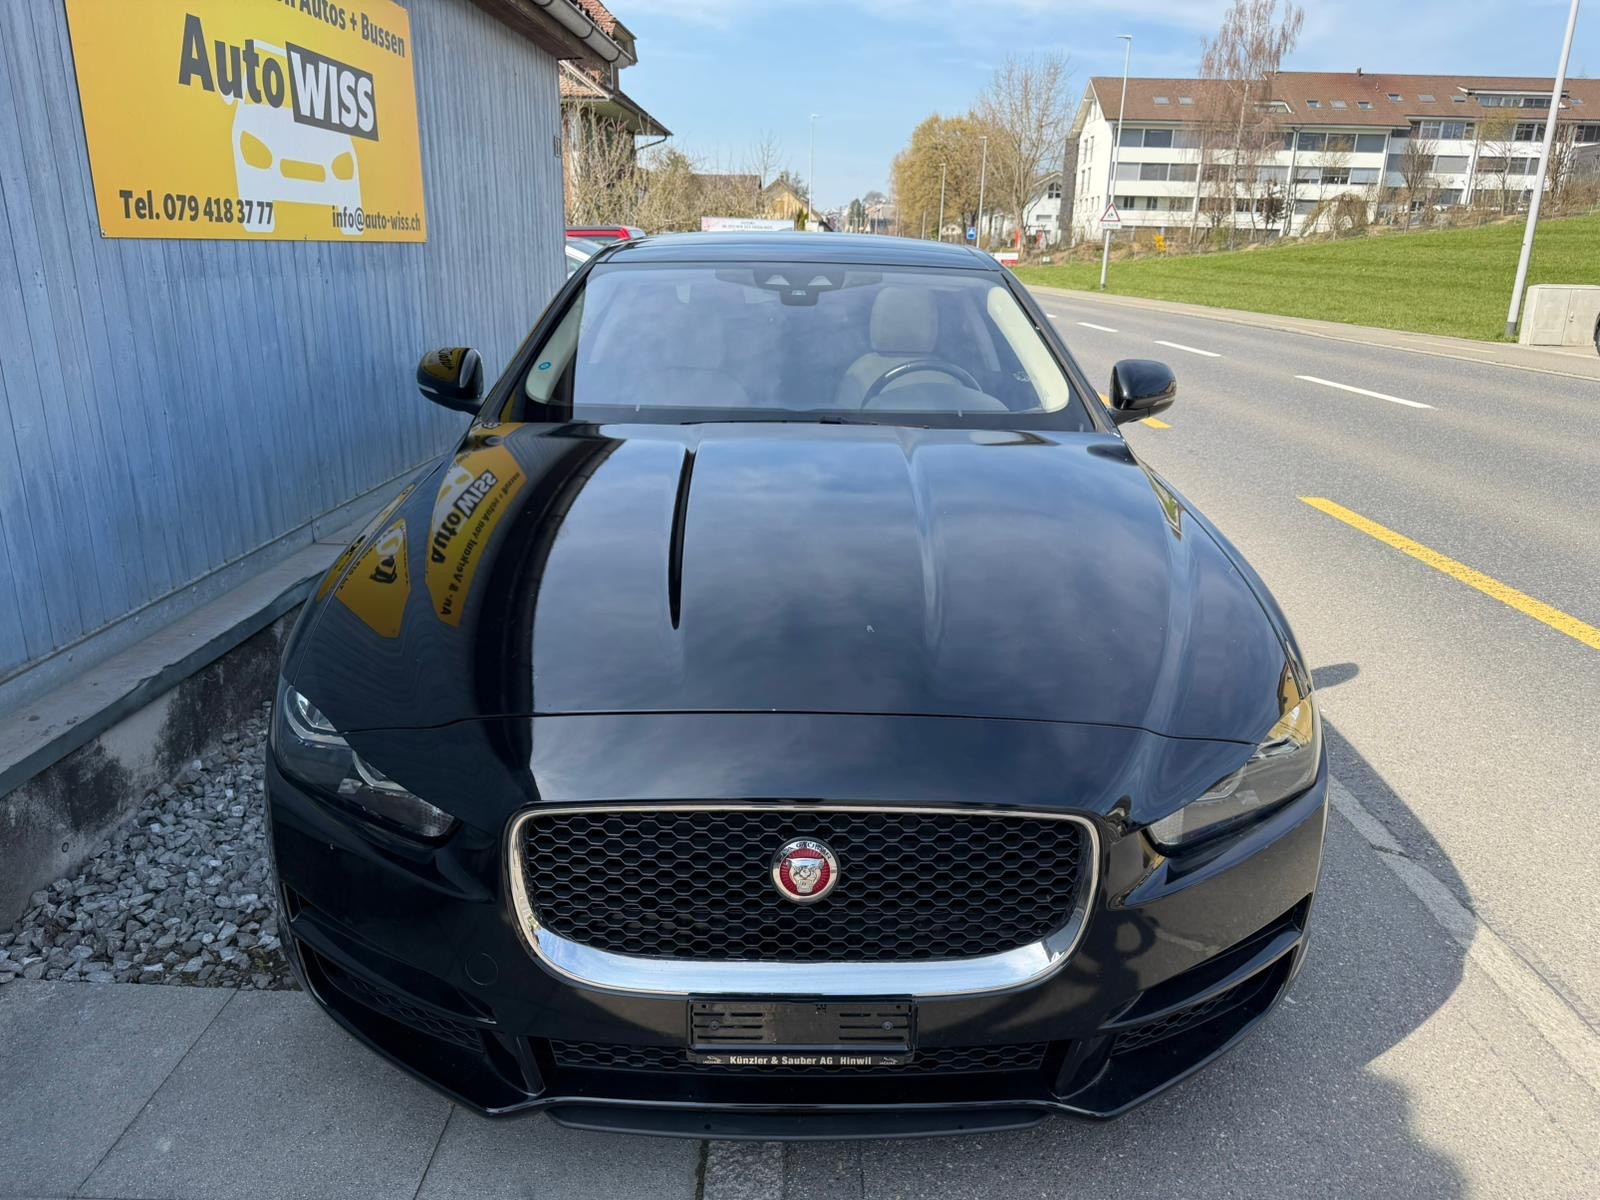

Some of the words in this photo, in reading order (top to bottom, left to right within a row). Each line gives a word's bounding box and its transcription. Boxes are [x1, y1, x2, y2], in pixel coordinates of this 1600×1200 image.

[361, 12, 405, 57] Bussen
[119, 190, 160, 220] Tel.
[163, 193, 199, 222] 079
[203, 197, 234, 223] 418
[237, 199, 254, 224] 37
[257, 201, 273, 224] 77
[332, 205, 421, 232] info@auto-wiss.ch
[730, 1055, 768, 1065] Künzler
[771, 1056, 779, 1065] &
[781, 1055, 816, 1065] Sauber
[820, 1056, 833, 1065] AG
[840, 1056, 871, 1065] Hinwil
